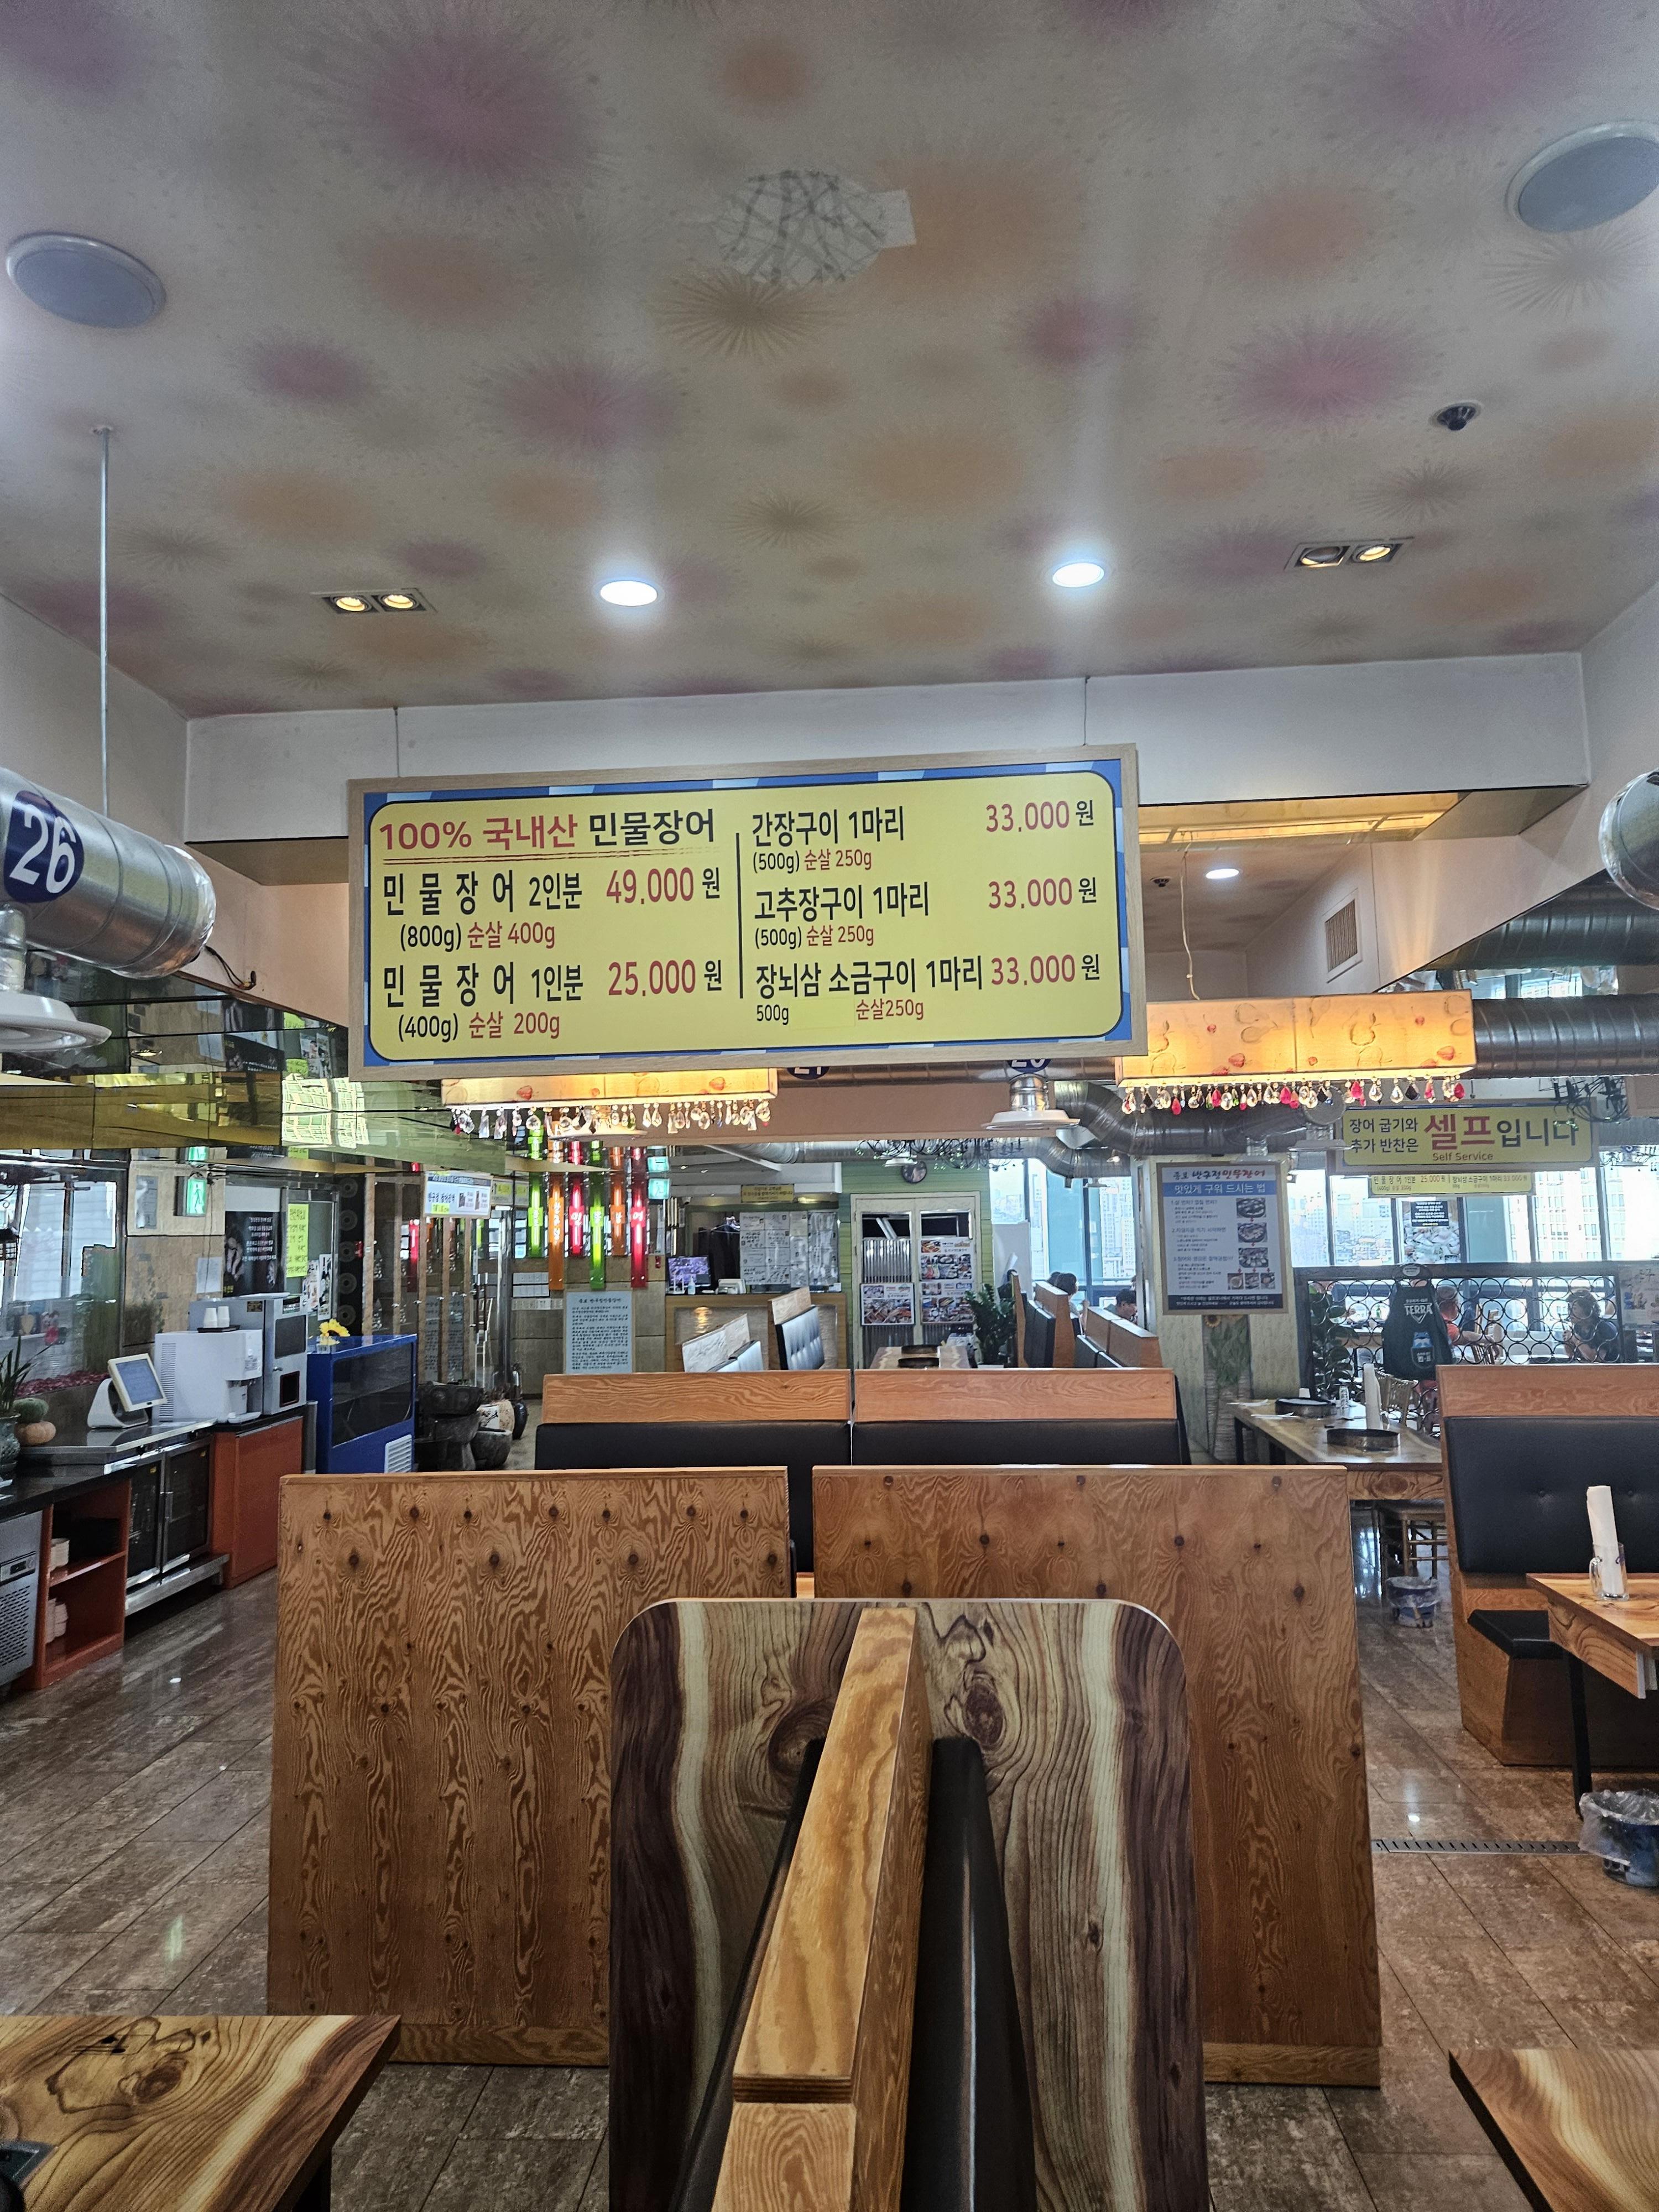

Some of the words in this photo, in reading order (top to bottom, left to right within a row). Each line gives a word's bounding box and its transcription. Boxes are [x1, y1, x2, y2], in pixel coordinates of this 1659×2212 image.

[379, 821, 471, 849] 100%
[483, 814, 578, 850] 국내산
[590, 809, 714, 847] 민물장어
[753, 809, 838, 847] 간장구이
[849, 806, 904, 842] 1마리
[987, 801, 1069, 832] 33.000
[1076, 800, 1093, 826] 원
[9, 804, 77, 894] 26
[754, 851, 799, 874] (500g)
[805, 849, 831, 870] 순살
[836, 849, 871, 870] 250g
[529, 873, 582, 910] 2인분
[607, 867, 693, 904] 49.000
[702, 867, 719, 899] 원
[755, 885, 862, 922] 고추장구이
[873, 882, 928, 917] 1마리
[989, 878, 1072, 909] 33.000
[1079, 877, 1096, 903] 원
[401, 923, 461, 952] (800g)
[468, 921, 502, 948] 순살
[508, 922, 554, 948] 400g
[755, 926, 801, 950] (500g)
[807, 925, 833, 946] 순살
[838, 925, 873, 946] 250g
[531, 965, 583, 1001] 1인분
[609, 959, 695, 996] 25.000
[705, 960, 722, 991] 원
[757, 963, 821, 999] 장뇌삼
[829, 958, 915, 995] 소금구이
[926, 956, 982, 991] 1마리
[992, 954, 1075, 985] 33.000
[1082, 954, 1099, 980] 원
[399, 1013, 458, 1042] (400g)
[469, 1011, 503, 1039] 순살
[514, 1012, 559, 1039] 200g
[757, 1004, 789, 1025] 500g
[1350, 1118, 1374, 1133] 장어
[1379, 1118, 1418, 1133] 굽기와
[1352, 1138, 1375, 1153] 추가
[1380, 1138, 1418, 1152] 반찬은
[1433, 1152, 1452, 1161] Self
[1455, 1151, 1493, 1160] Service
[1175, 1185, 1201, 1194] 맛있게
[1205, 1185, 1222, 1193] 구워
[1226, 1184, 1254, 1193] 드시는
[1257, 1183, 1265, 1193] 법
[1405, 1305, 1433, 1316] TERRA
